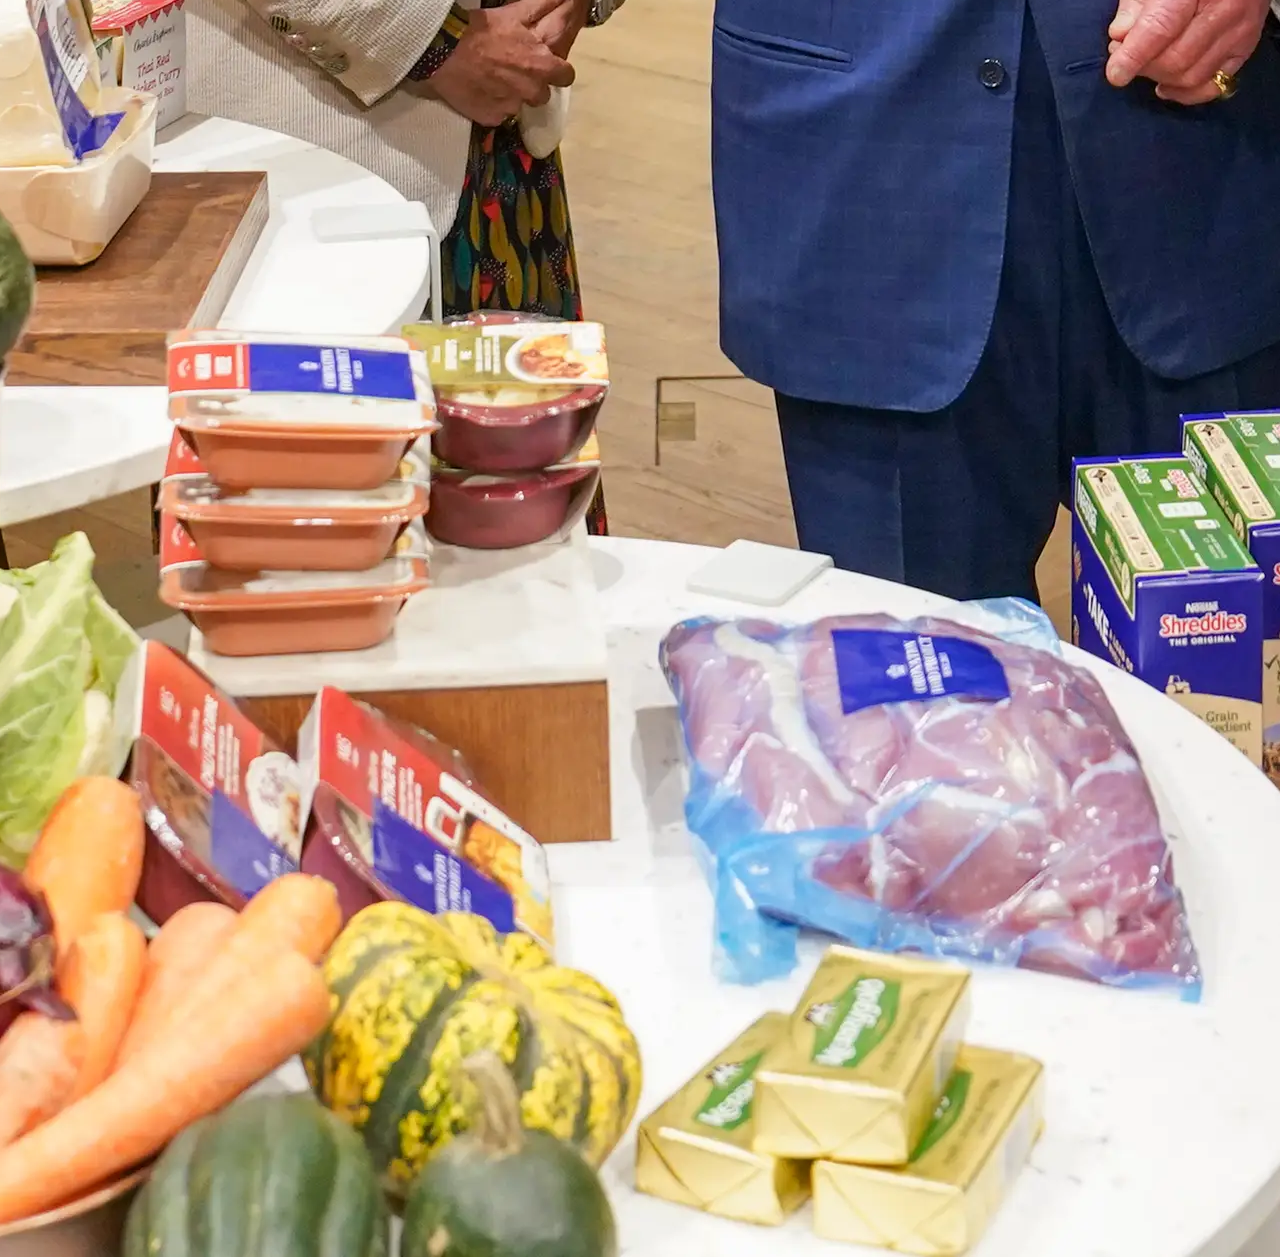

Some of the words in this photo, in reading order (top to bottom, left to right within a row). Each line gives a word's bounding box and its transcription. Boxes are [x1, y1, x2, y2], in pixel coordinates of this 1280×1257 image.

[1159, 612, 1247, 638] Shreddies
[1168, 636, 1190, 647] THE
[1190, 634, 1237, 646] ORIGINAL
[1205, 709, 1239, 723] Grain
